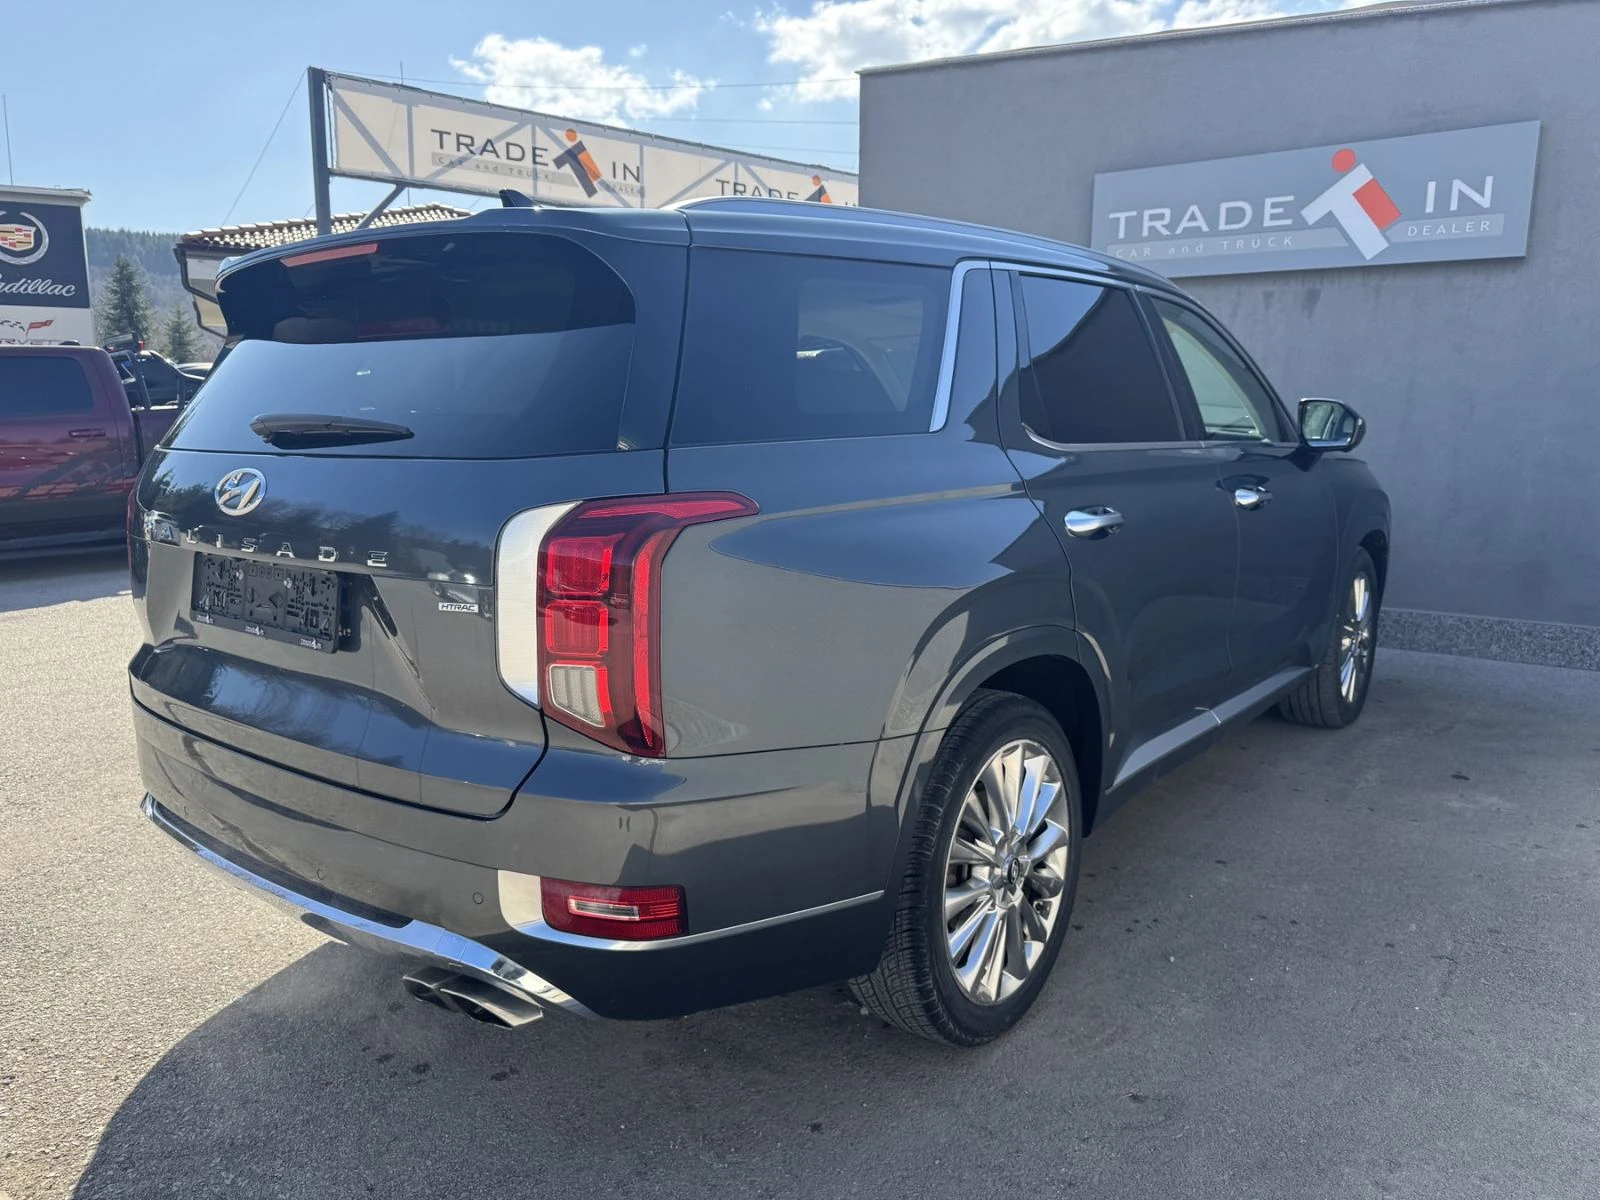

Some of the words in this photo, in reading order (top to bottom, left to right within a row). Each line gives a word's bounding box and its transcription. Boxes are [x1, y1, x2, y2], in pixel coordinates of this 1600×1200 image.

[430, 128, 549, 167] TRADE
[612, 160, 641, 183] IN
[508, 167, 552, 180] TRUK
[1108, 195, 1295, 240] TRADE
[1424, 175, 1494, 214] IN
[1115, 247, 1152, 259] CAR
[1167, 242, 1204, 255] and
[1220, 235, 1294, 250] TRUCK
[1407, 220, 1491, 237] DEALER
[0, 273, 76, 297] dillac
[152, 522, 388, 568] ALISADE
[440, 603, 477, 612] HTRAC
